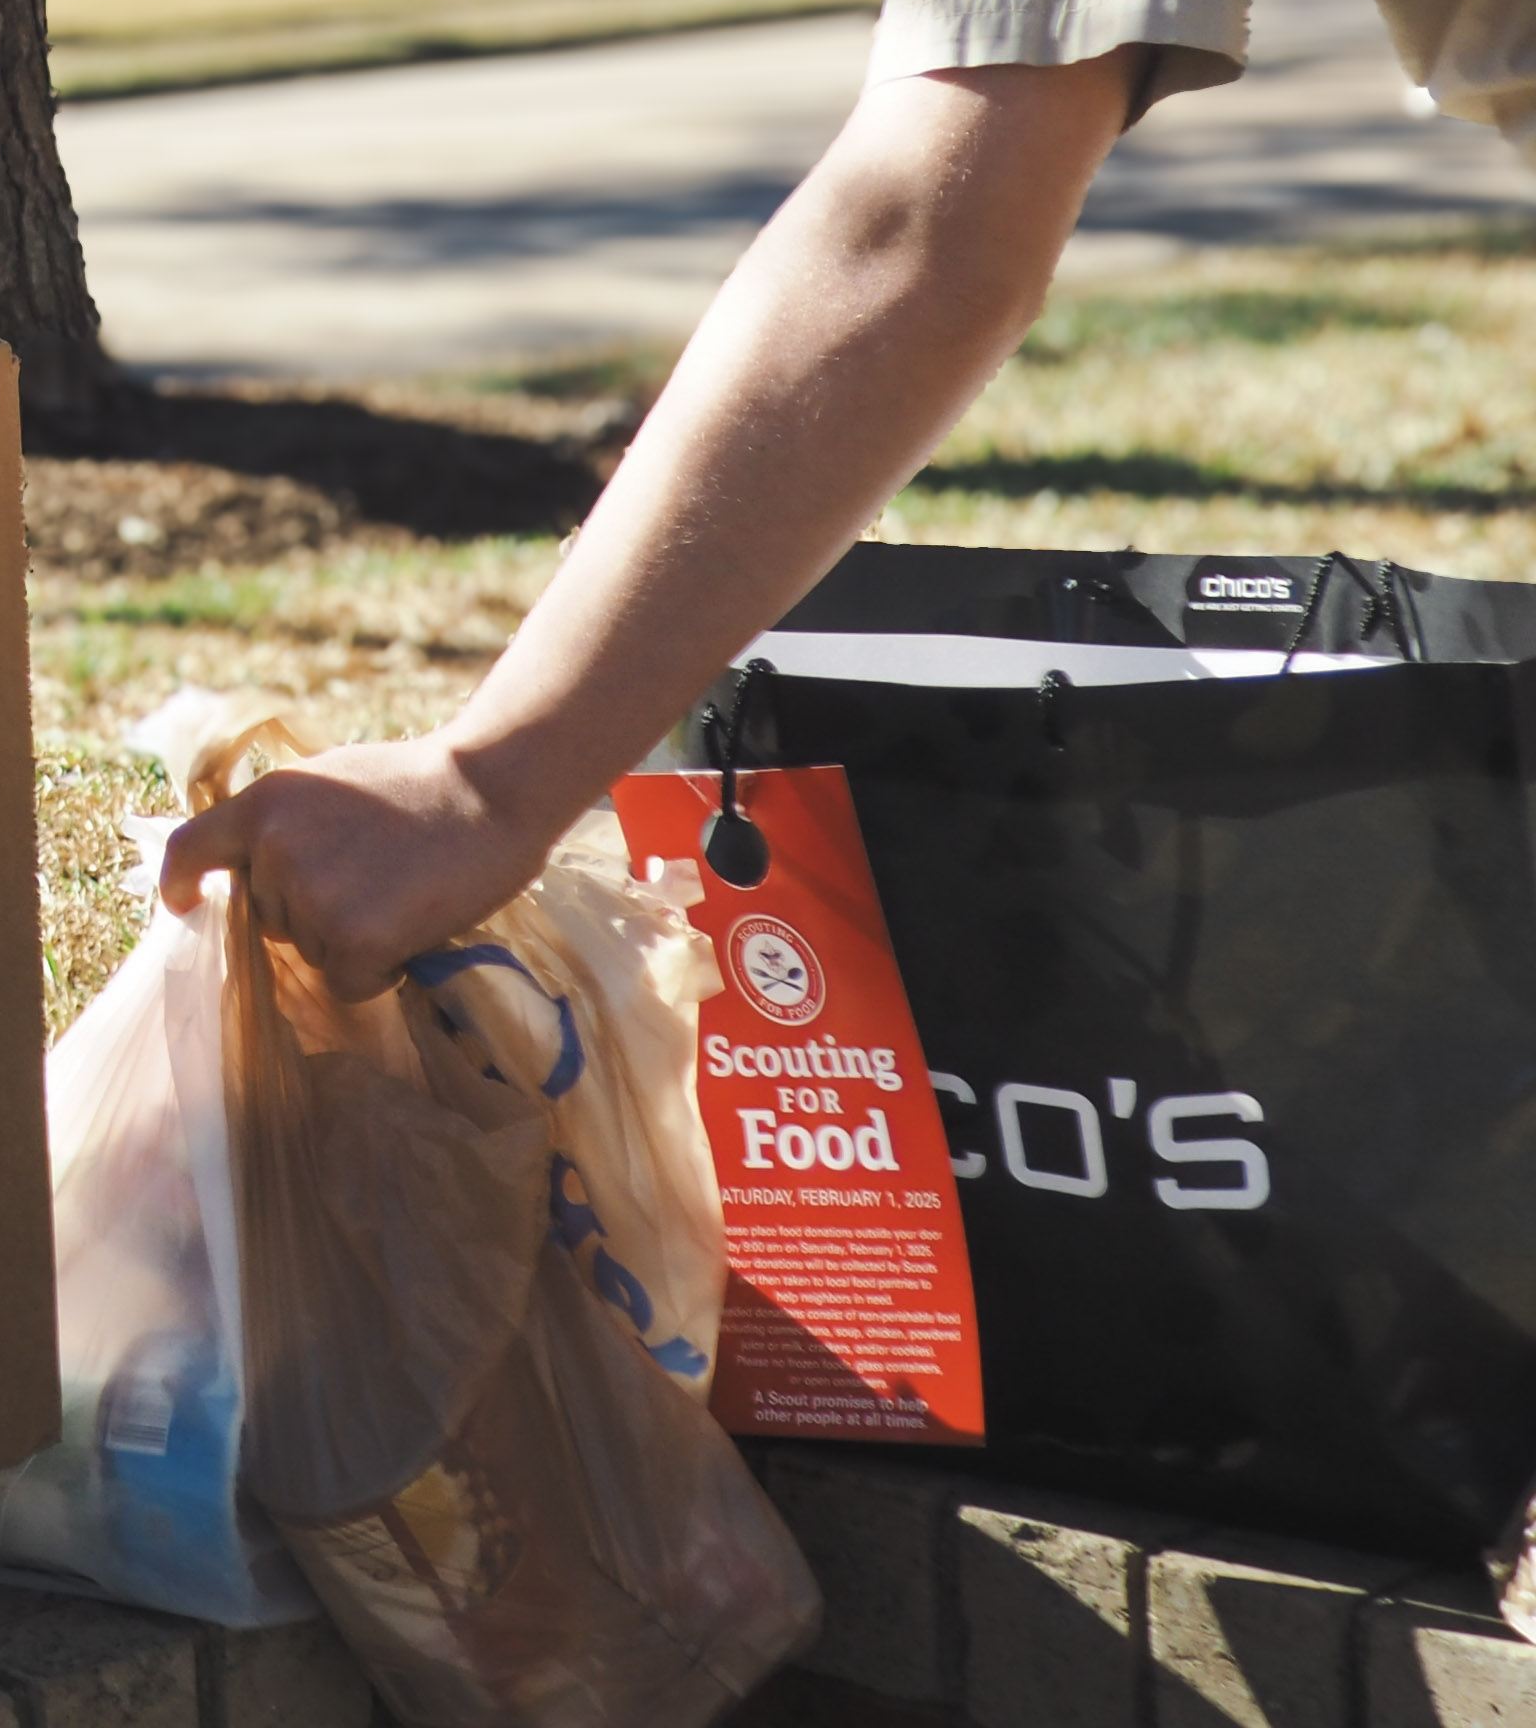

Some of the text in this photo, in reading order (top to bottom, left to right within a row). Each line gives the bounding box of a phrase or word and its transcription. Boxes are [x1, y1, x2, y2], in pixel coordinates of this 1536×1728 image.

[737, 921, 795, 944] SCOUTING
[759, 997, 816, 1019] FOR FOOD
[704, 1032, 903, 1092] Scouting
[777, 1086, 844, 1115] FOR
[736, 1107, 900, 1171] Food
[721, 1187, 942, 1210] ATURDAY, FEBRUARY 1, 2025
[754, 1390, 929, 1414] A Scout promises to help
[754, 1409, 793, 1422] other
[796, 1410, 842, 1426] people
[846, 1412, 861, 1426] at
[864, 1412, 881, 1426] all
